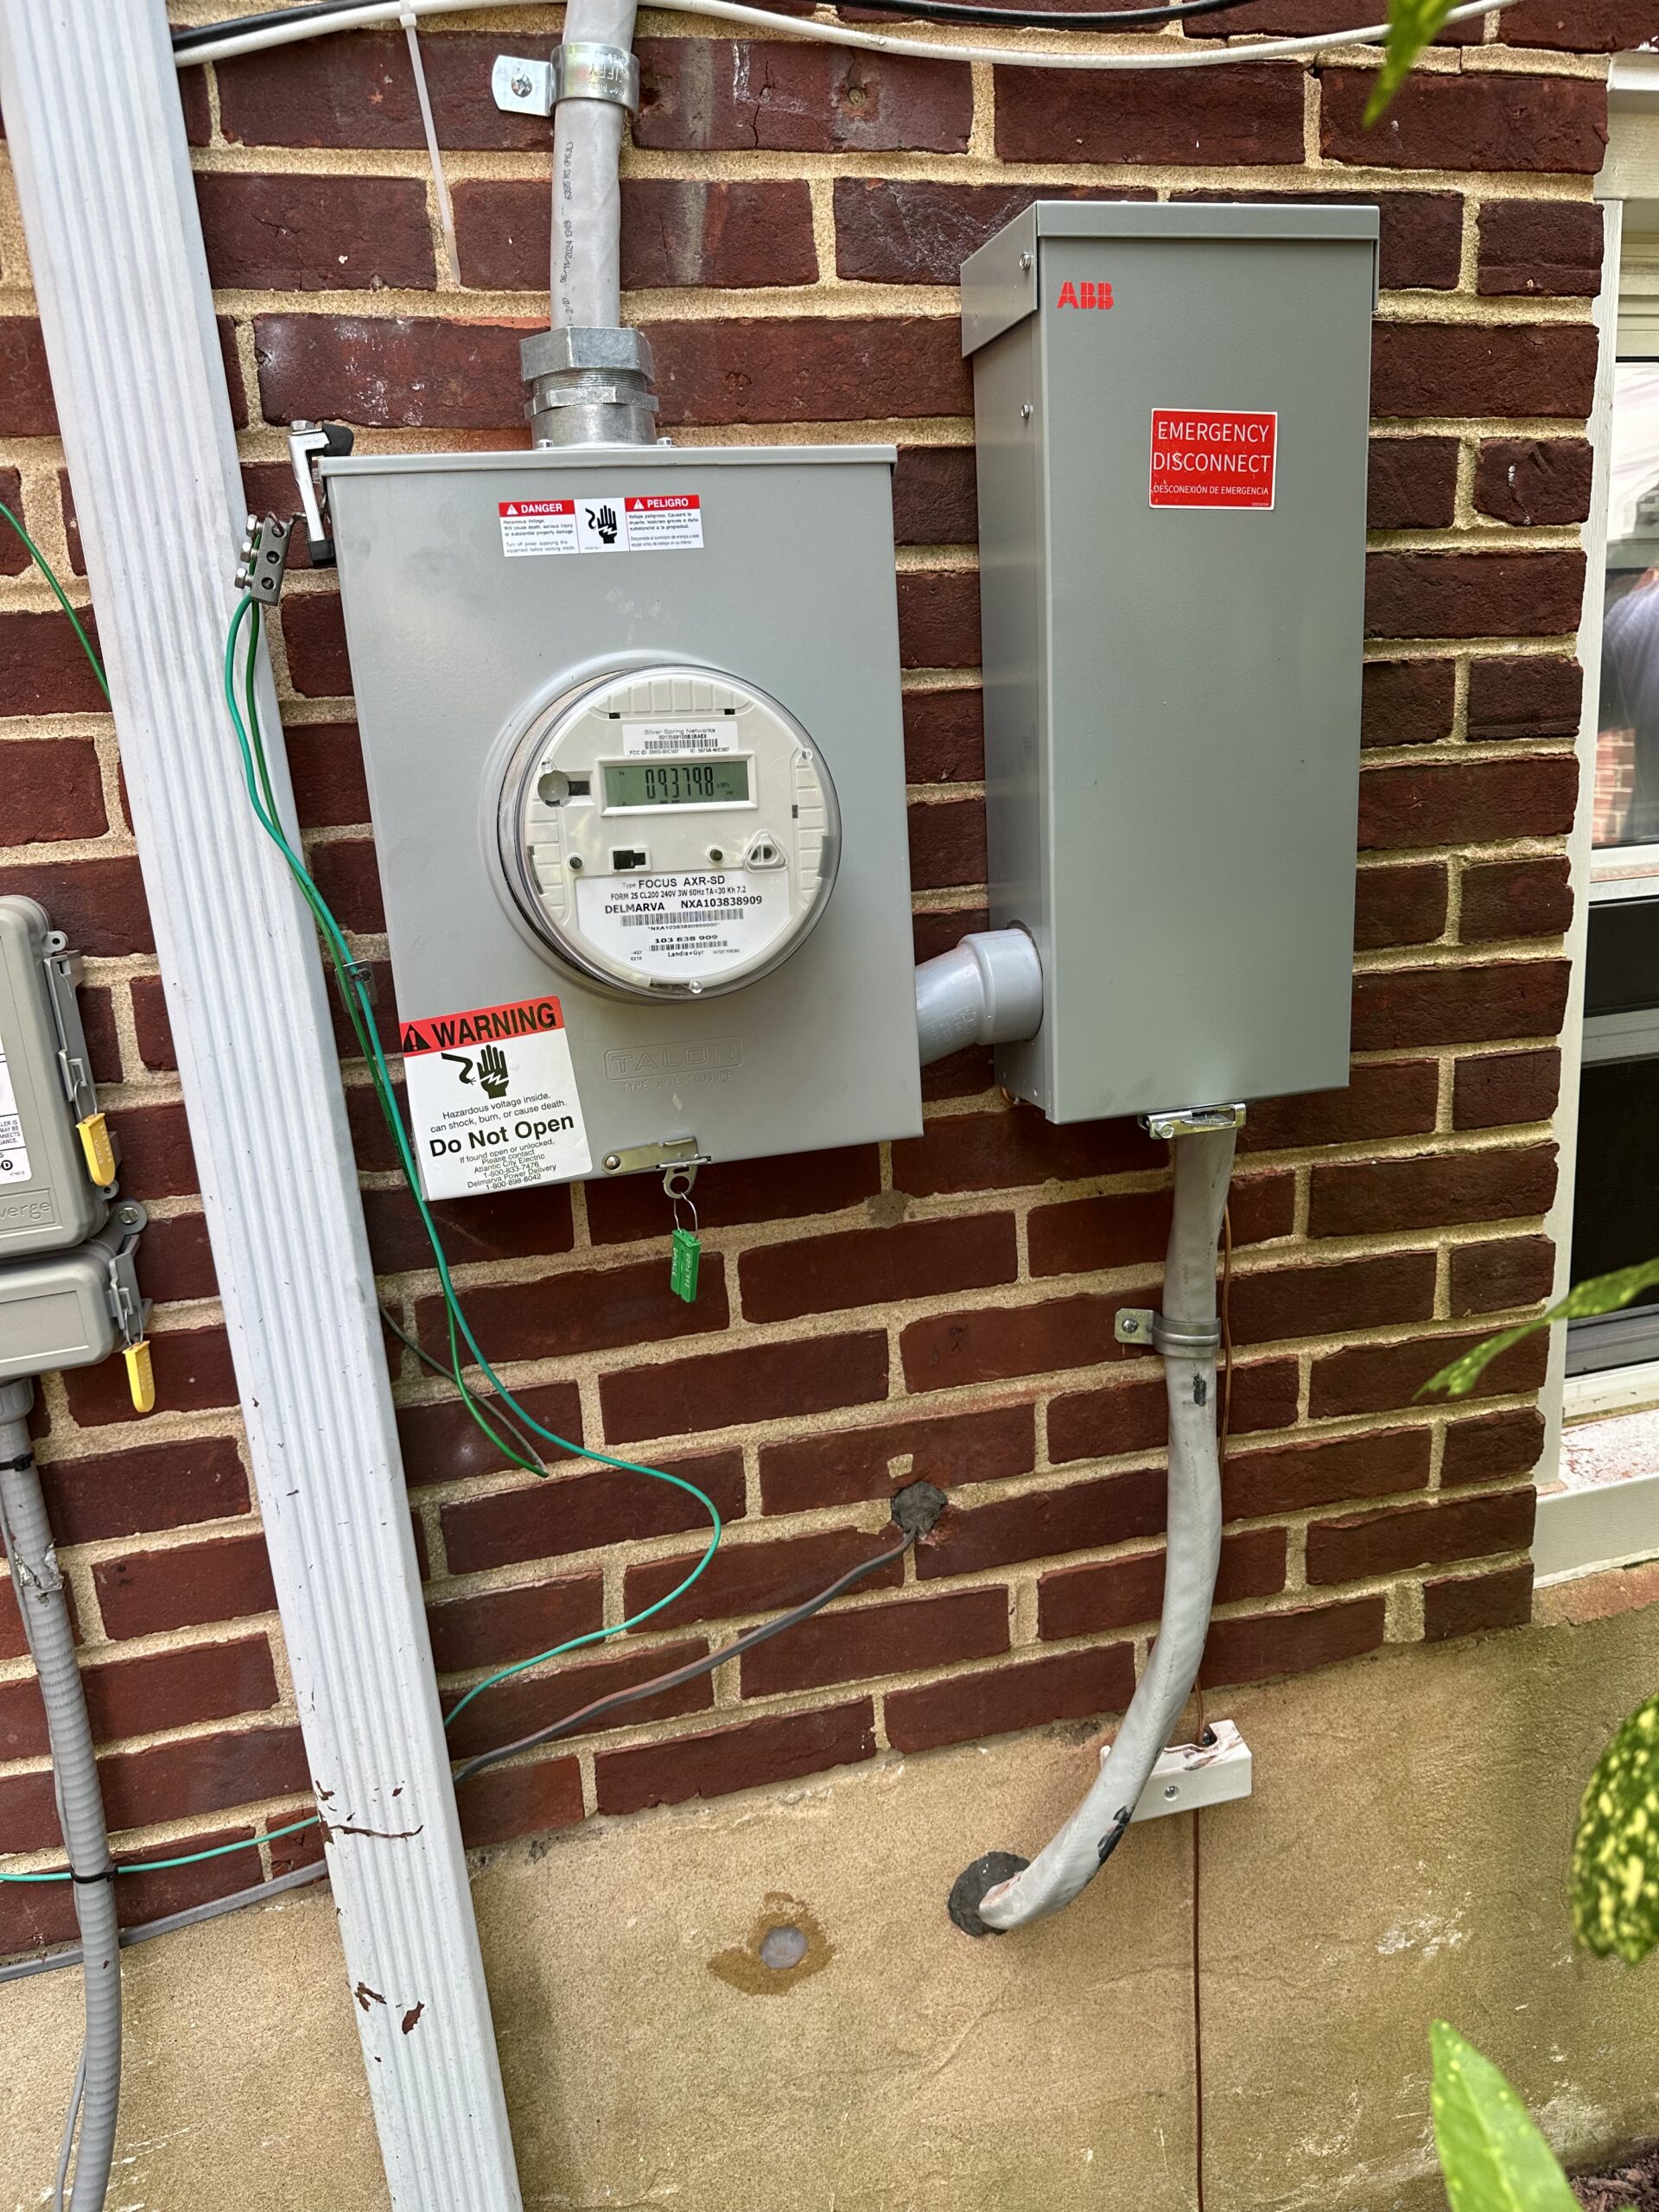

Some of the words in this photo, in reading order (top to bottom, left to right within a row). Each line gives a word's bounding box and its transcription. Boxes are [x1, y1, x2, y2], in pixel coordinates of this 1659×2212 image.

[1057, 281, 1114, 310] ABB
[1158, 421, 1269, 443] EMERGENCY
[1153, 451, 1271, 473] DISCONNECT
[1154, 483, 1208, 494] DESCONEXIÓN
[1209, 486, 1219, 494] DE
[1221, 486, 1269, 495] EMERGENCIA
[520, 503, 563, 514] DANGER
[646, 498, 690, 509] PELIGRO
[664, 728, 684, 737] Spring
[645, 766, 715, 799] 093798
[610, 893, 630, 901] FORM
[631, 892, 639, 900] 2S
[639, 891, 660, 899] CL200
[660, 889, 677, 899] 240V
[689, 887, 705, 896] 60Hz
[705, 887, 727, 895] TA=30
[736, 885, 747, 893] 7.2
[621, 881, 637, 891] Type
[638, 877, 678, 890] FOCUS
[683, 874, 727, 887] AXR-SD
[604, 901, 666, 914] DELMARVA
[681, 895, 763, 910] NXA103838909
[430, 1002, 557, 1048] WARNING
[611, 1042, 738, 1074] TALON
[430, 1123, 447, 1133] can
[448, 1118, 477, 1130] shock,
[478, 1113, 501, 1124] burn,
[503, 1110, 512, 1119] or
[513, 1105, 539, 1116] cause
[540, 1098, 568, 1111] death.
[442, 1105, 490, 1121] Hazardous
[491, 1096, 522, 1111] voltage
[523, 1091, 550, 1105] inside.
[429, 1138, 462, 1158] Do
[467, 1126, 510, 1150] Not
[514, 1115, 575, 1141] Open
[466, 1151, 488, 1163] found
[489, 1147, 510, 1159] open
[519, 1137, 556, 1152] unlocked,
[481, 1155, 507, 1166] Please
[508, 1148, 536, 1160] contact
[474, 1161, 502, 1174] Atlantic
[502, 1159, 518, 1169] City
[518, 1153, 546, 1165] Electric
[467, 1175, 503, 1189] Delmarva
[504, 1169, 527, 1181] Power
[528, 1163, 557, 1176] Delivery
